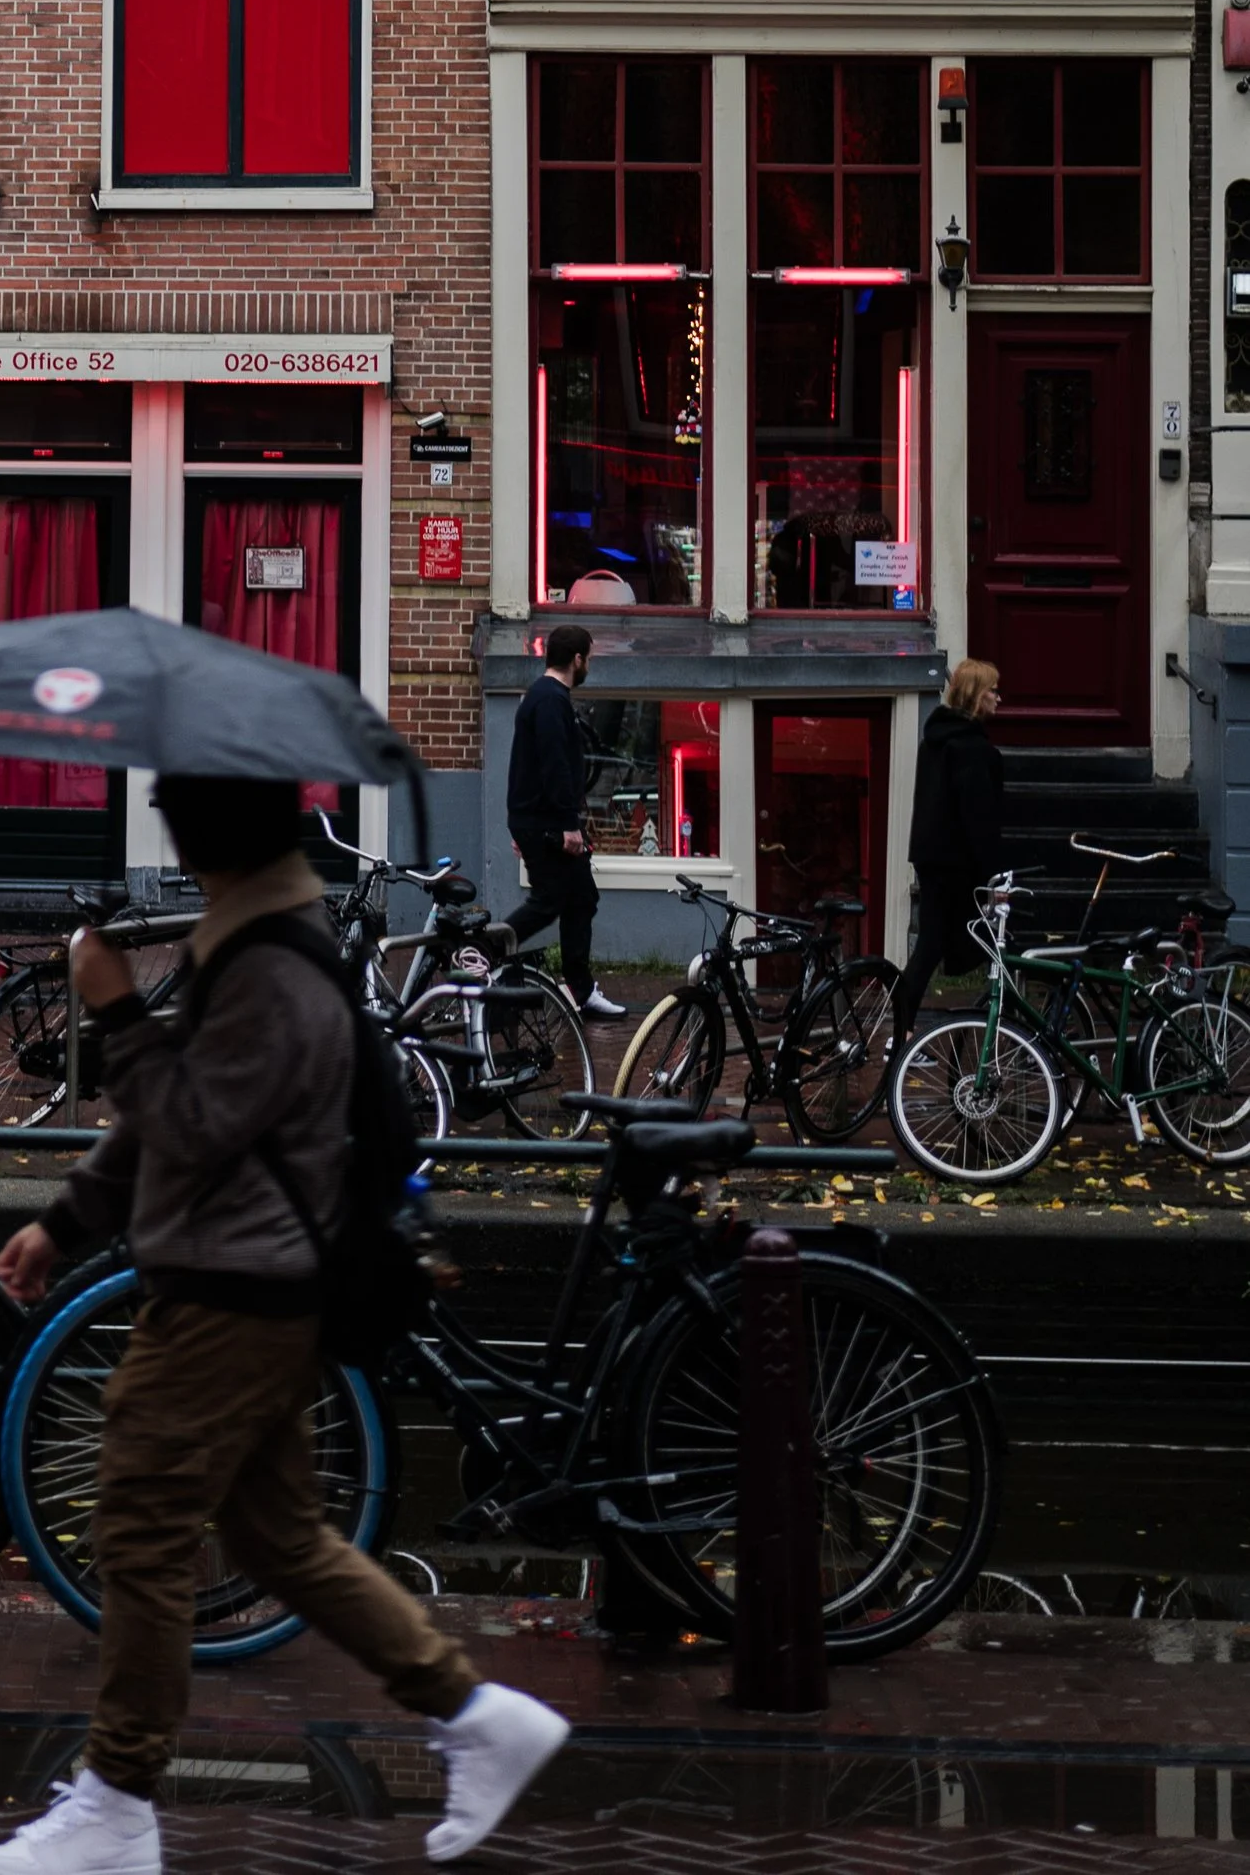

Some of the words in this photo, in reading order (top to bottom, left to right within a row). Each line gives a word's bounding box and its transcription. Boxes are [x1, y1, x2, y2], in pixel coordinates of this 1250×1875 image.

[12, 351, 78, 371] Office
[88, 352, 115, 371] 52
[224, 353, 379, 373] 020-6386421
[1166, 406, 1178, 433] 70
[434, 468, 449, 482] 72
